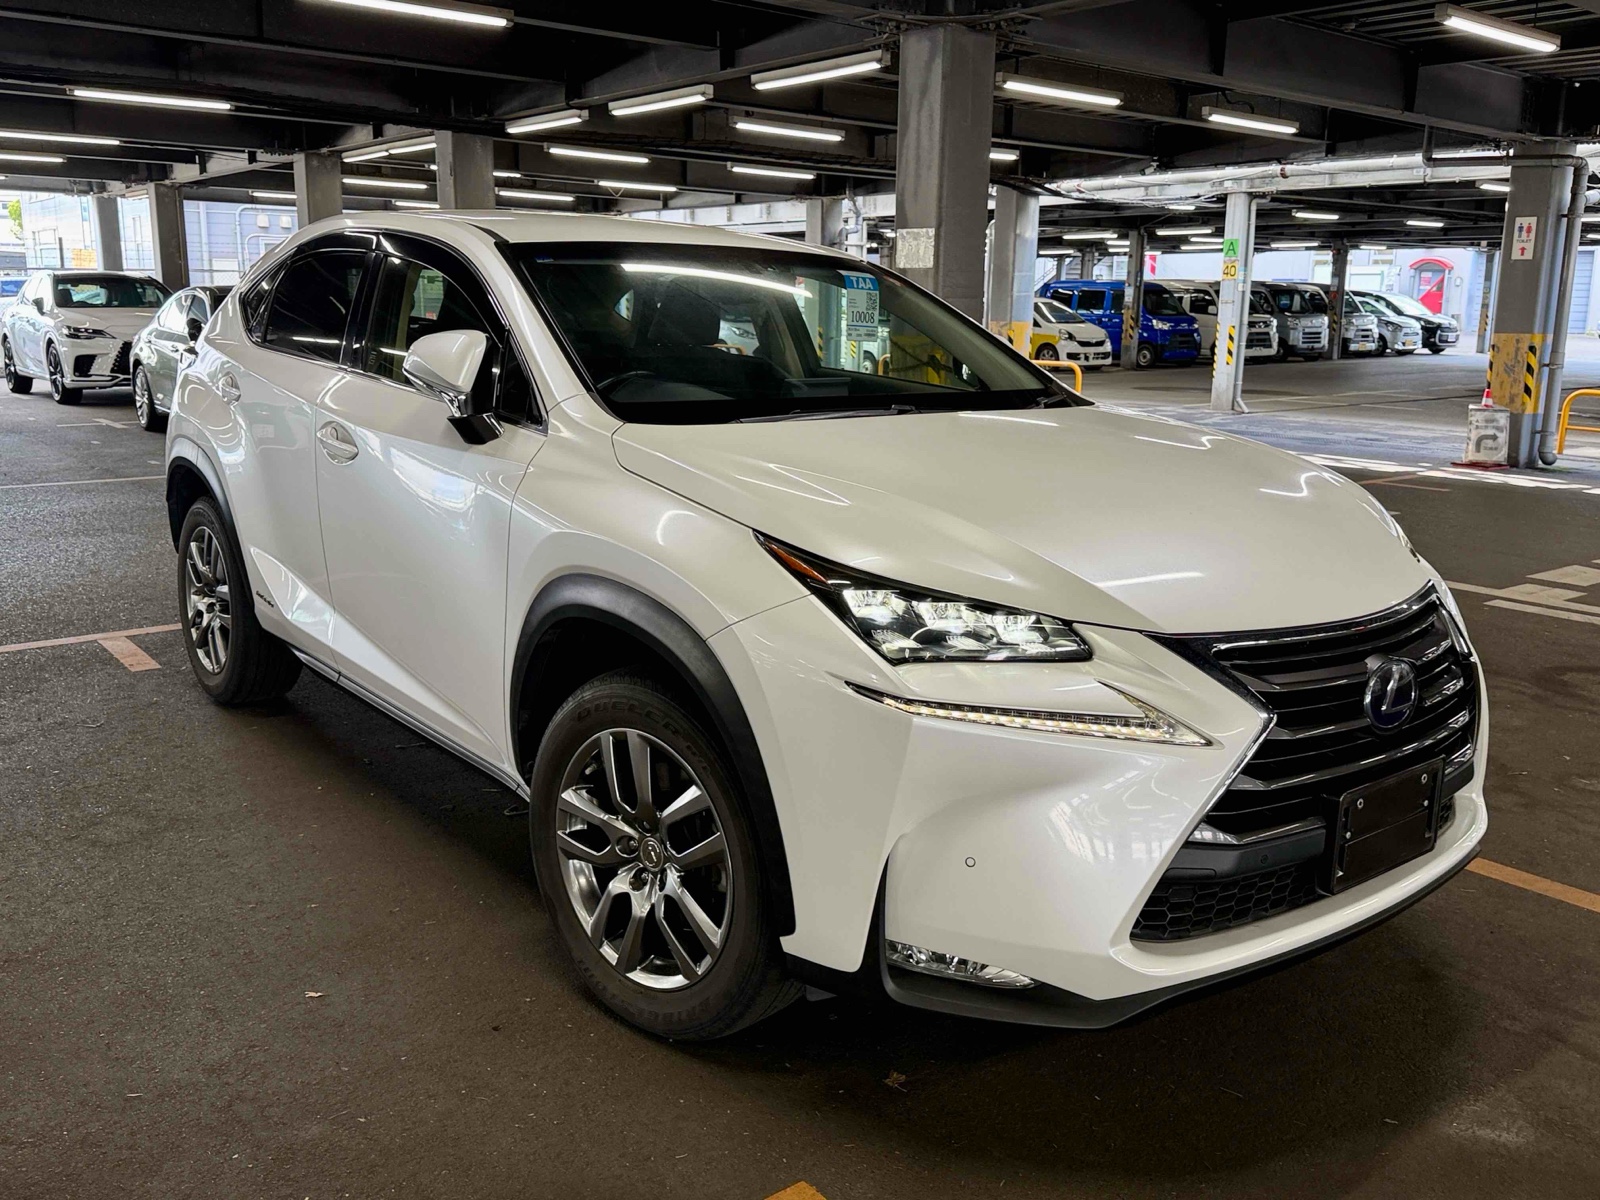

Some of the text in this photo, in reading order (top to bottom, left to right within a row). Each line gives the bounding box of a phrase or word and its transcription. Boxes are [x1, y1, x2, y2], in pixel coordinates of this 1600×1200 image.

[1225, 241, 1237, 255] A
[1223, 265, 1237, 277] 40
[849, 277, 874, 289] TAA
[851, 310, 875, 324] 10008
